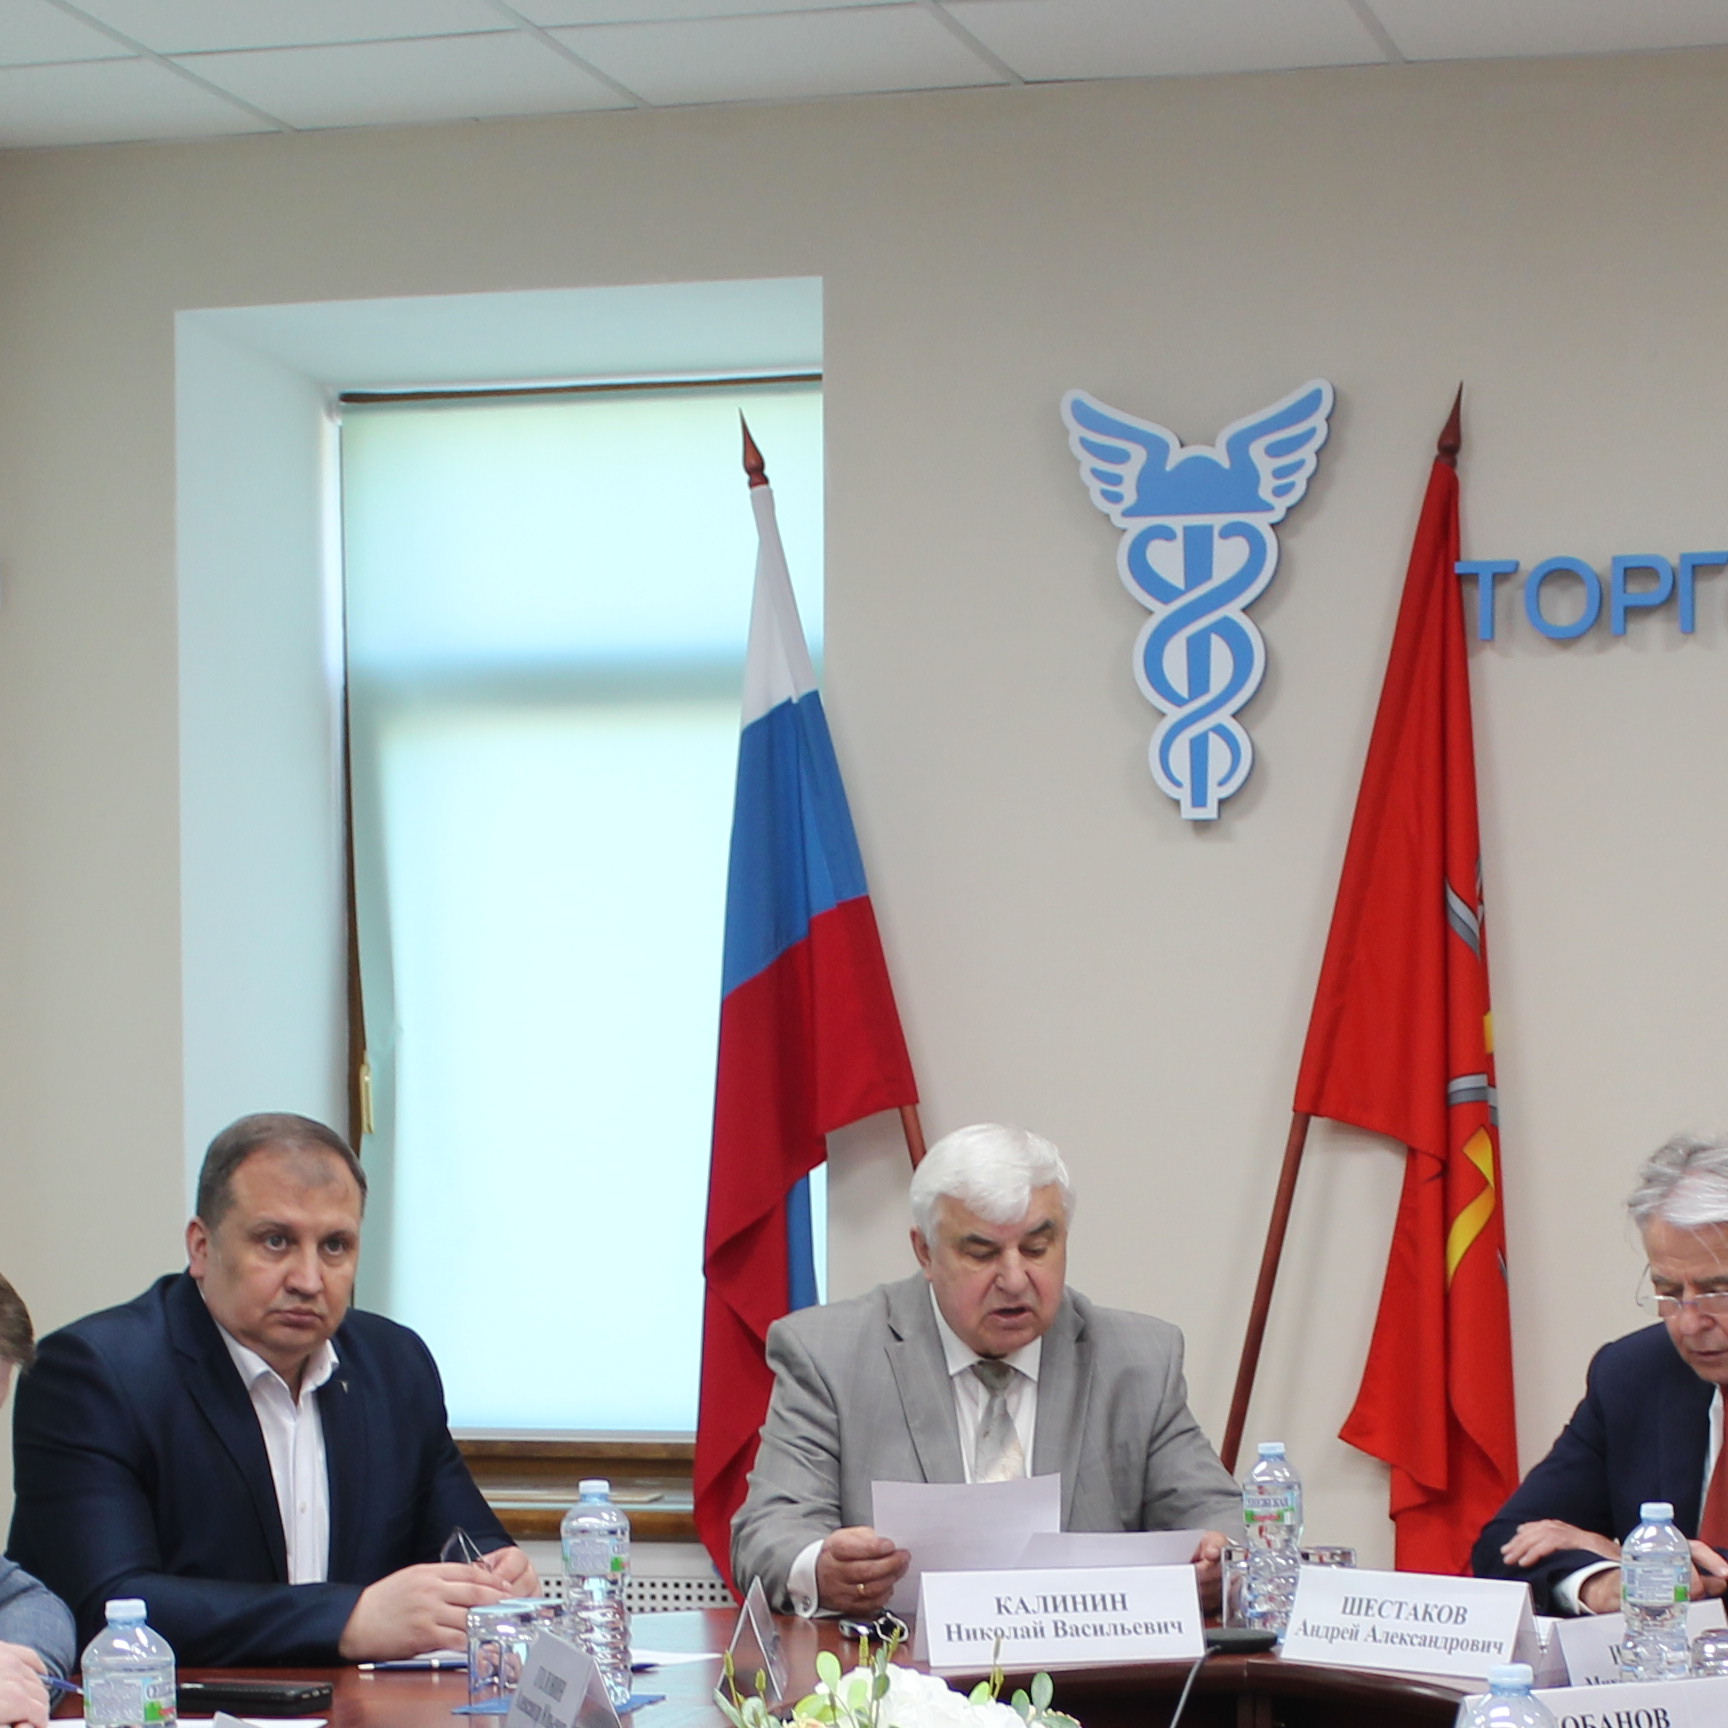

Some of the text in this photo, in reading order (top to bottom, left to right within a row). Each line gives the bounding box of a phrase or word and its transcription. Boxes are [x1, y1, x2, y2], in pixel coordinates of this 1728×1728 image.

[995, 1593, 1128, 1615] КАЛИНИН
[1341, 1596, 1468, 1626] ШЕСТАКОВ
[945, 1619, 1184, 1643] Николай Васильевич
[1294, 1618, 1504, 1655] Андрей Александрович
